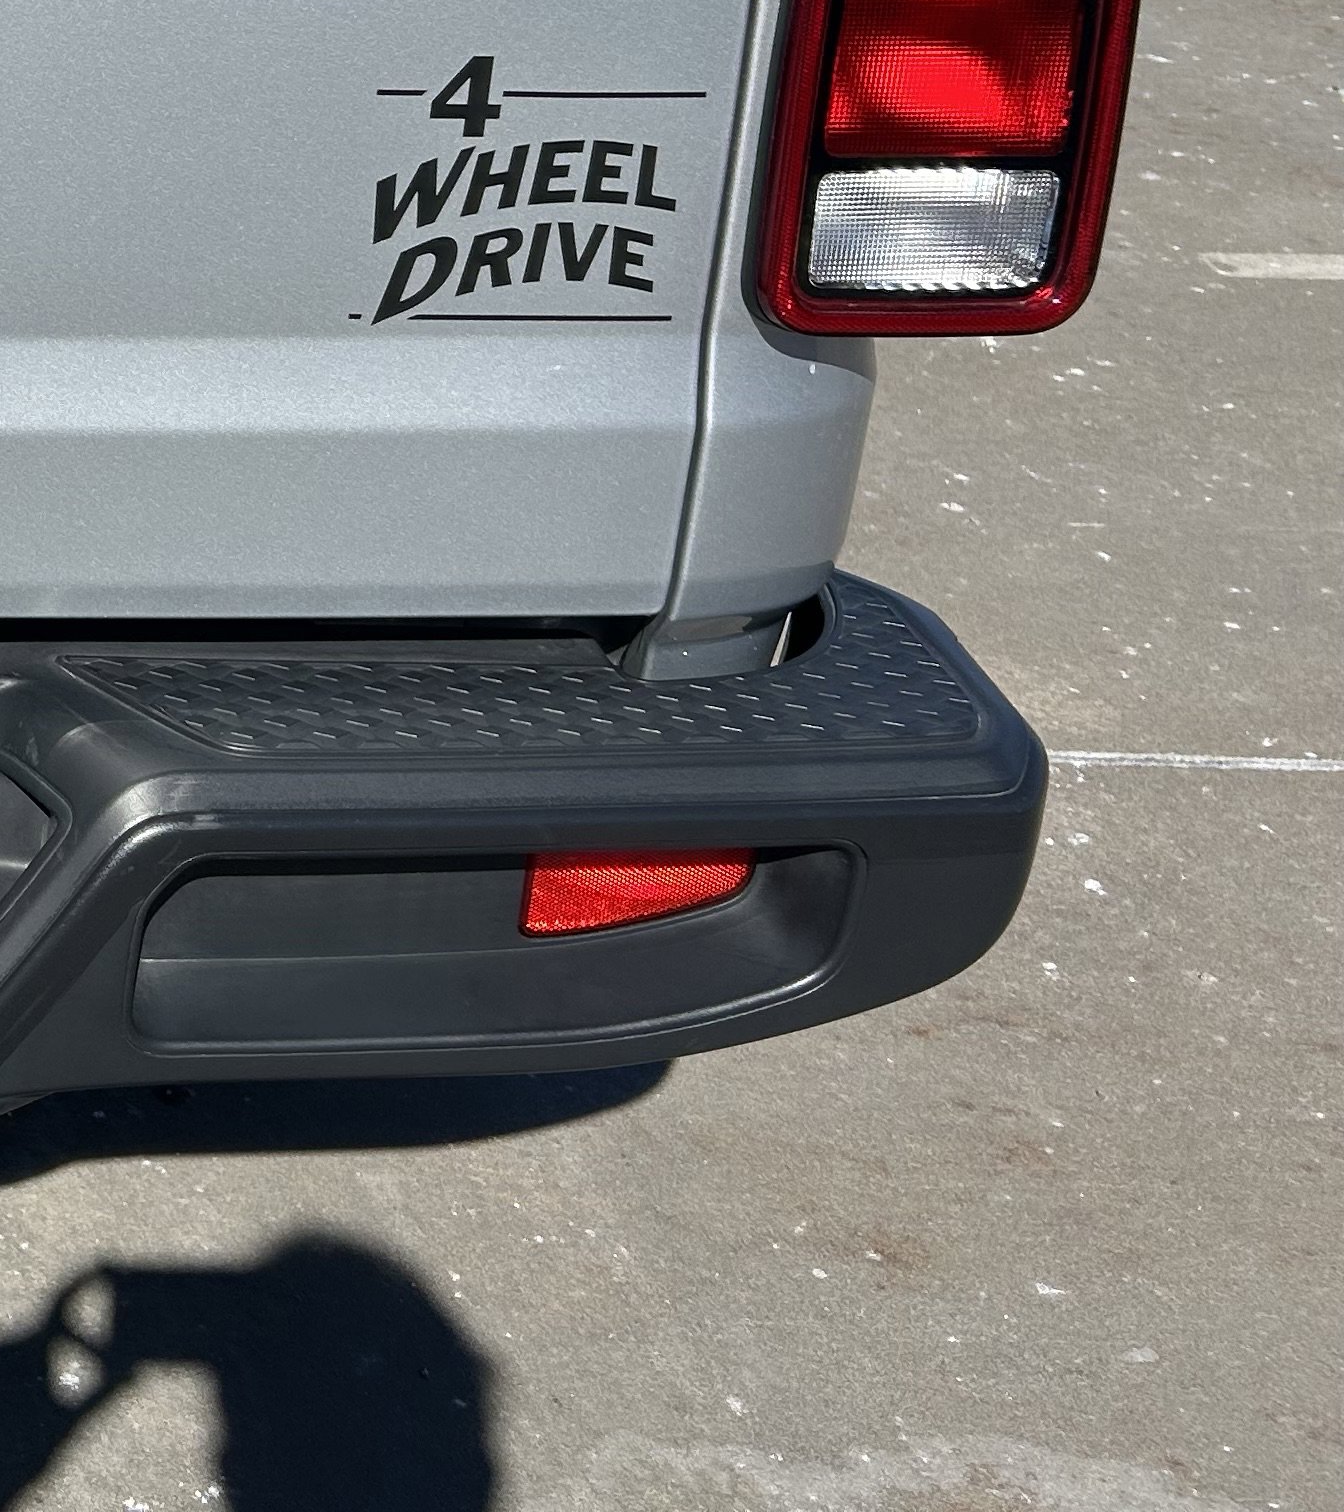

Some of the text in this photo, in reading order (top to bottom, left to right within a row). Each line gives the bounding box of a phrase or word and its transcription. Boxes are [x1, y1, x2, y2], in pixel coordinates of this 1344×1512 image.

[429, 55, 502, 137] 4
[372, 139, 677, 245] WHEEL
[370, 221, 654, 326] DRIVE
